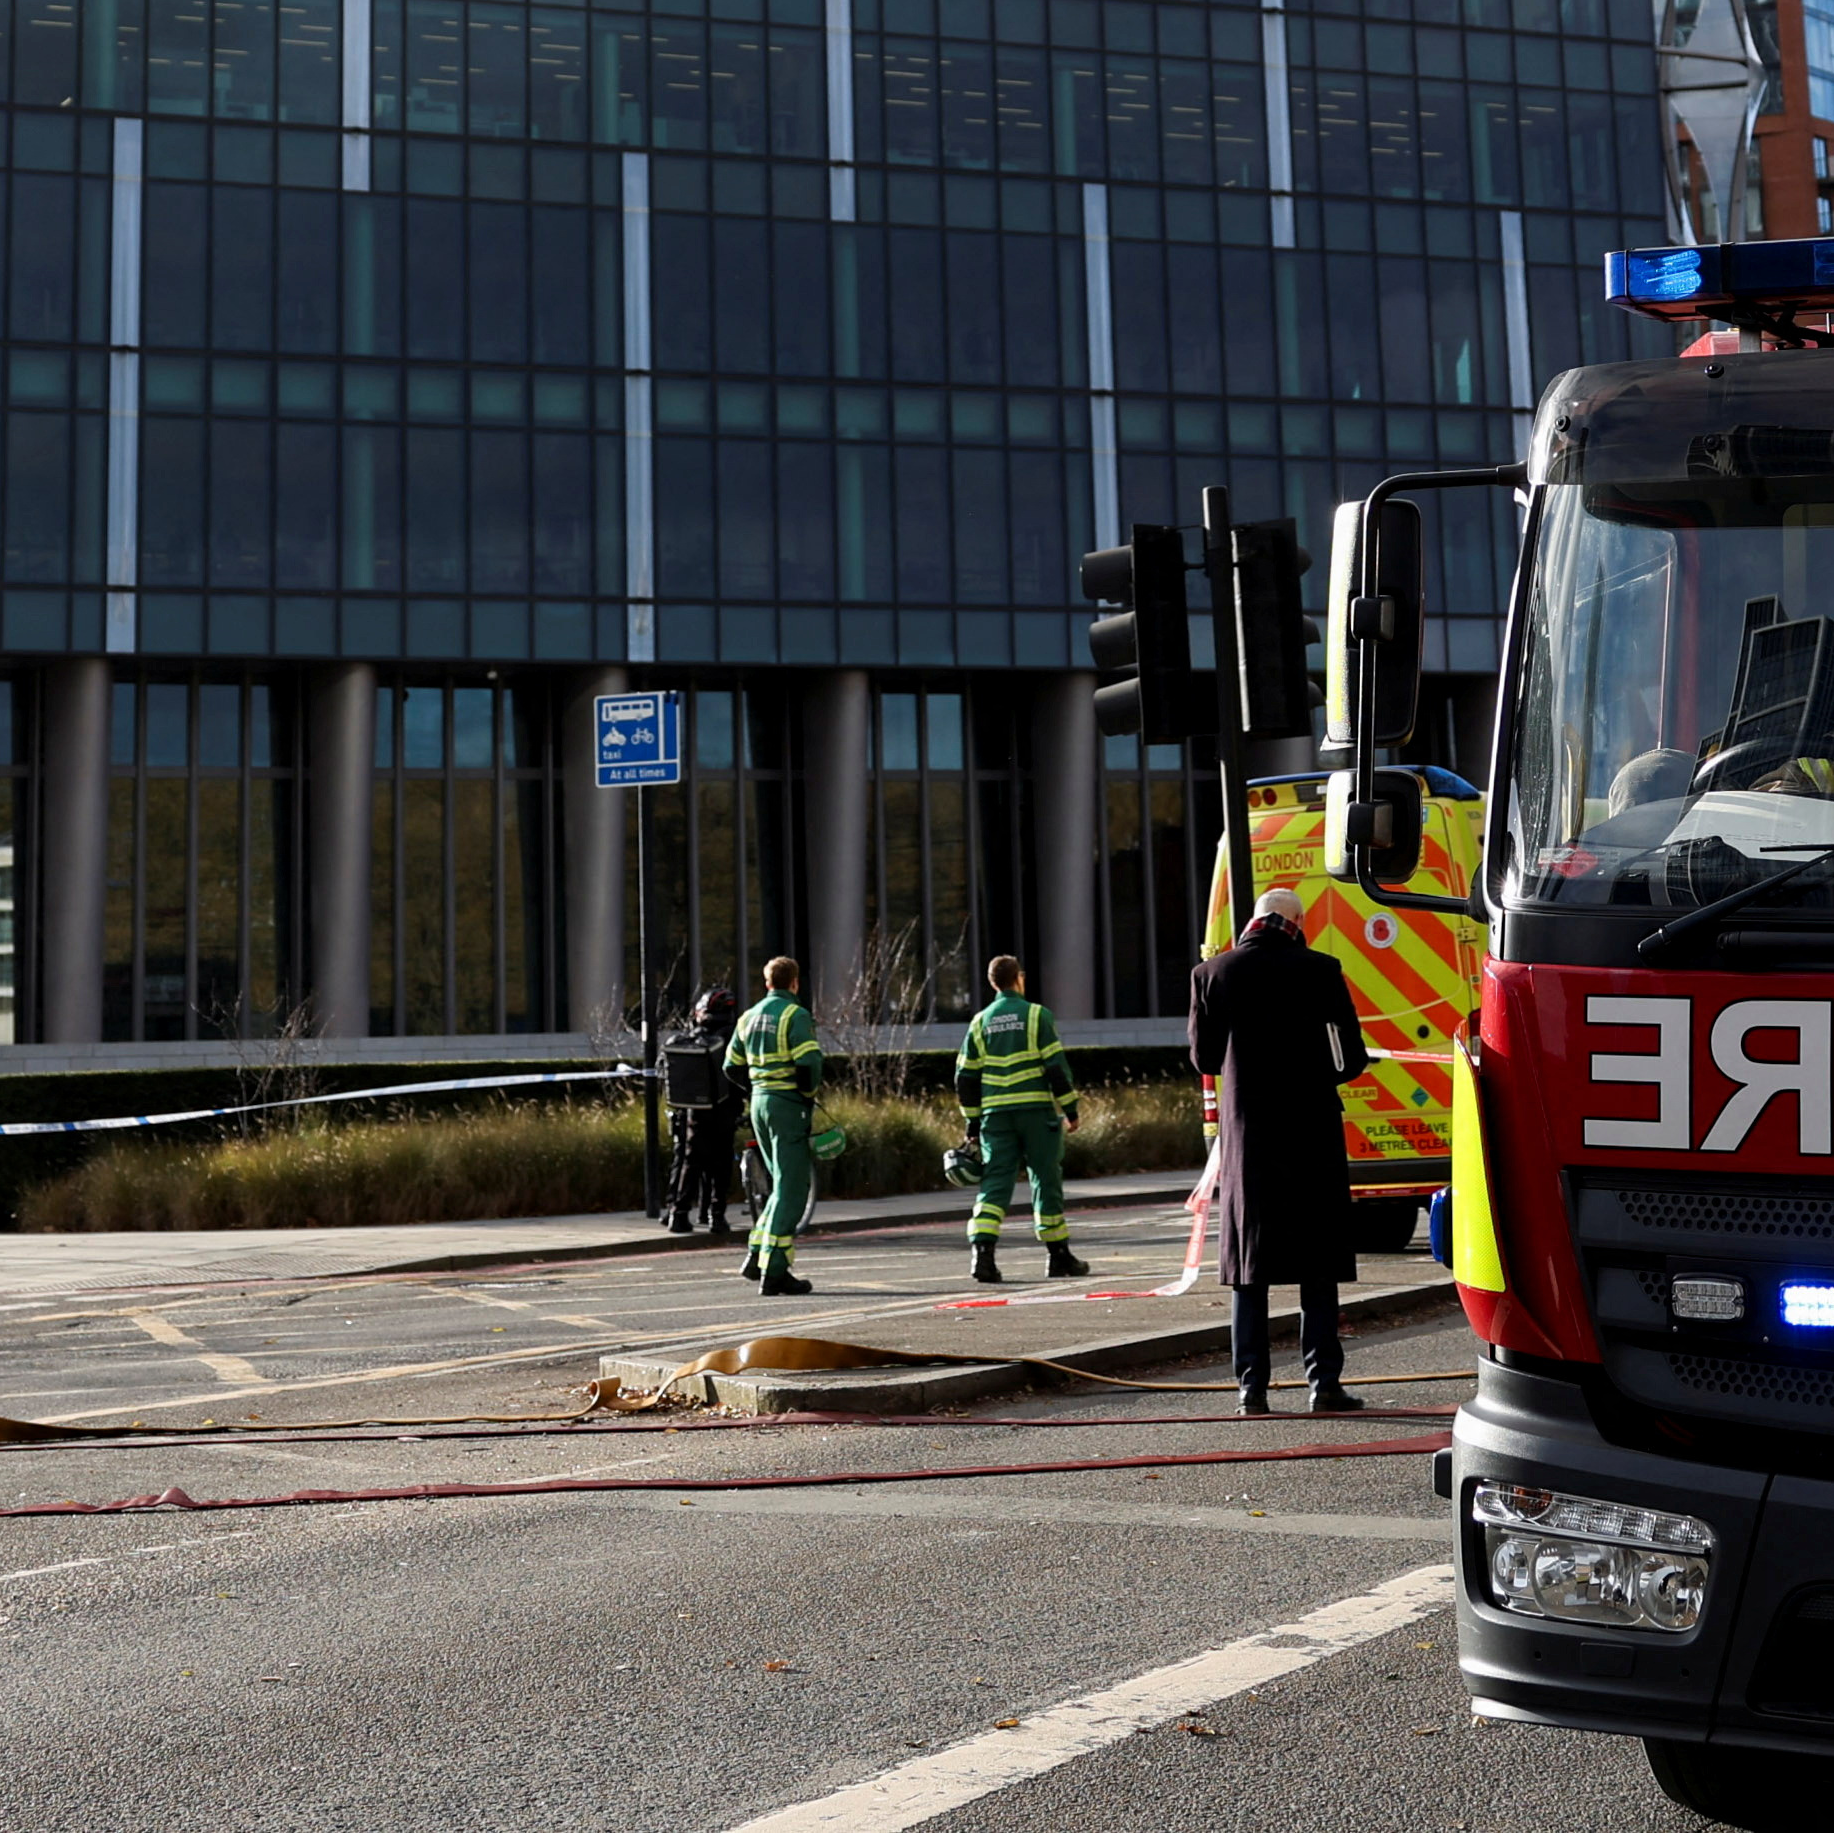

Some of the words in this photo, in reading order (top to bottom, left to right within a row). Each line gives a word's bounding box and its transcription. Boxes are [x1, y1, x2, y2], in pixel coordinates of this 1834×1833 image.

[602, 749, 622, 760] taxi
[610, 769, 622, 780] At
[624, 767, 637, 779] all
[639, 766, 666, 778] times
[1255, 850, 1314, 873] LONDON
[1366, 1124, 1409, 1137] PLEASE
[1411, 1122, 1448, 1135] LEAVE
[1360, 1142, 1367, 1153] 3
[1369, 1140, 1415, 1152] METRES
